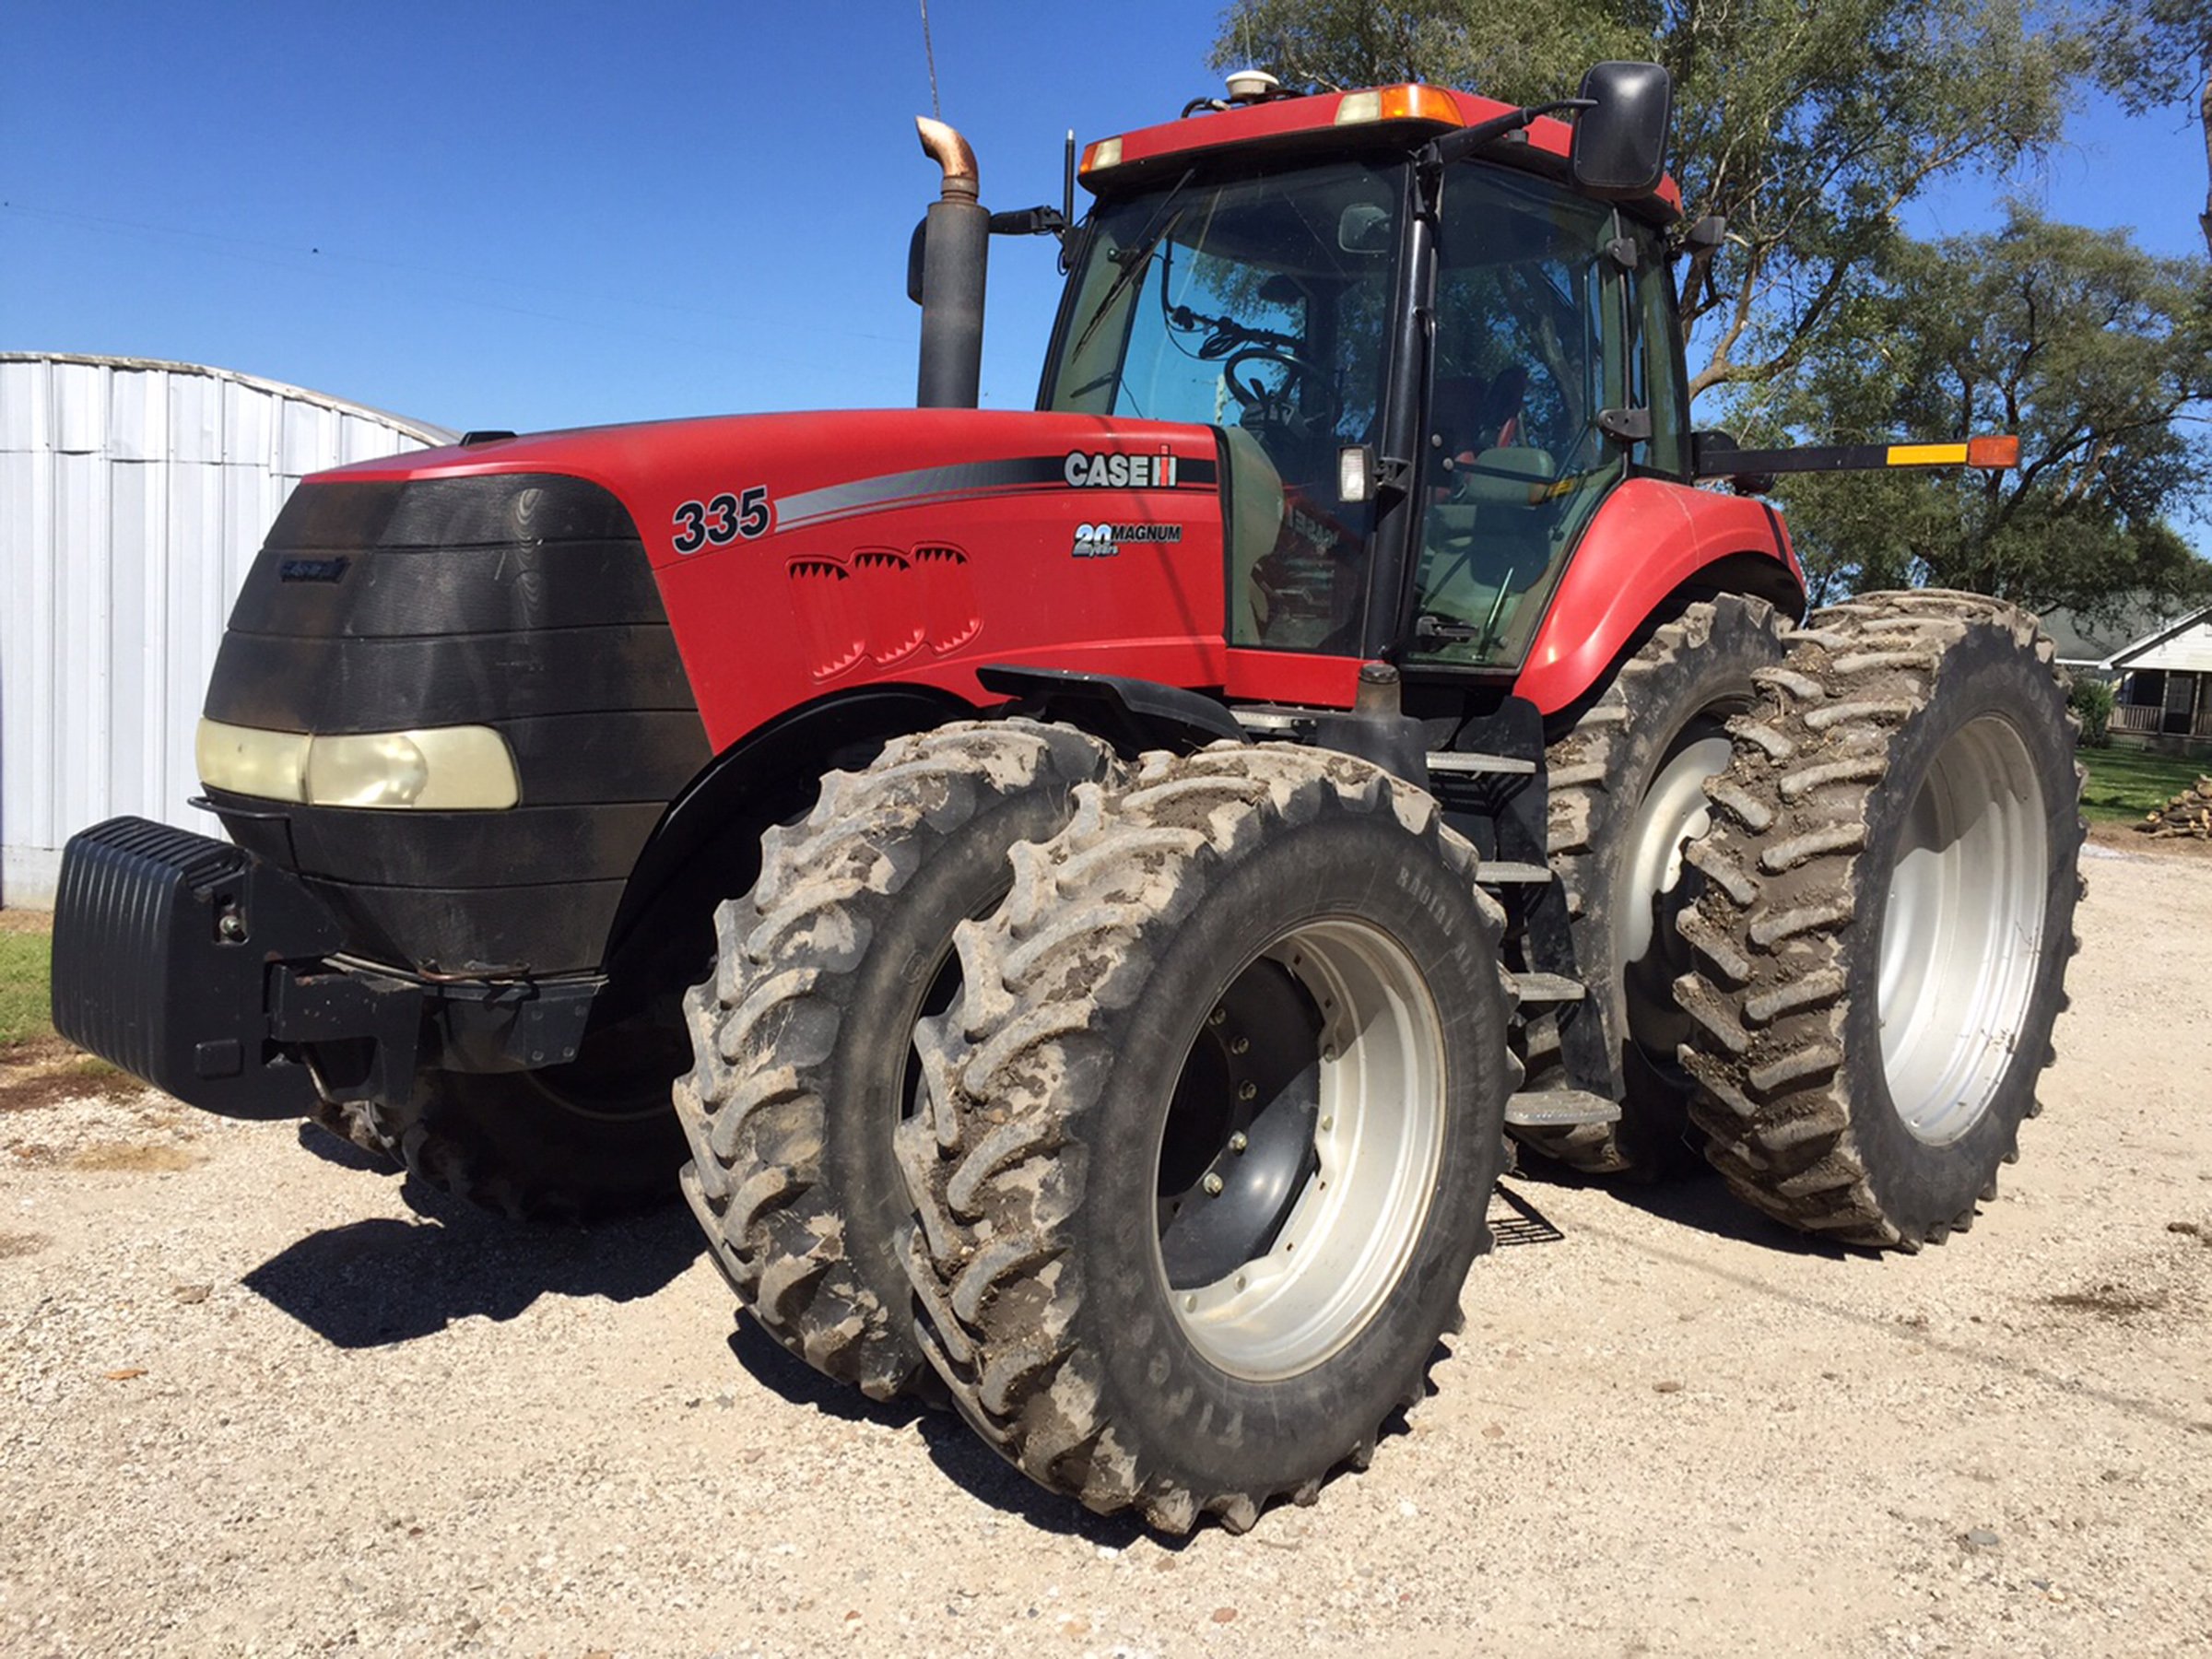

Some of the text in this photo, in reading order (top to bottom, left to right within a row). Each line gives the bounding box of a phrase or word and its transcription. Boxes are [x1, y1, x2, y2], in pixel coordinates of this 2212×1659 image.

[672, 484, 771, 555] 335
[1073, 523, 1182, 556] 20 MAGNUM
[1396, 867, 1453, 936] RADIAL
